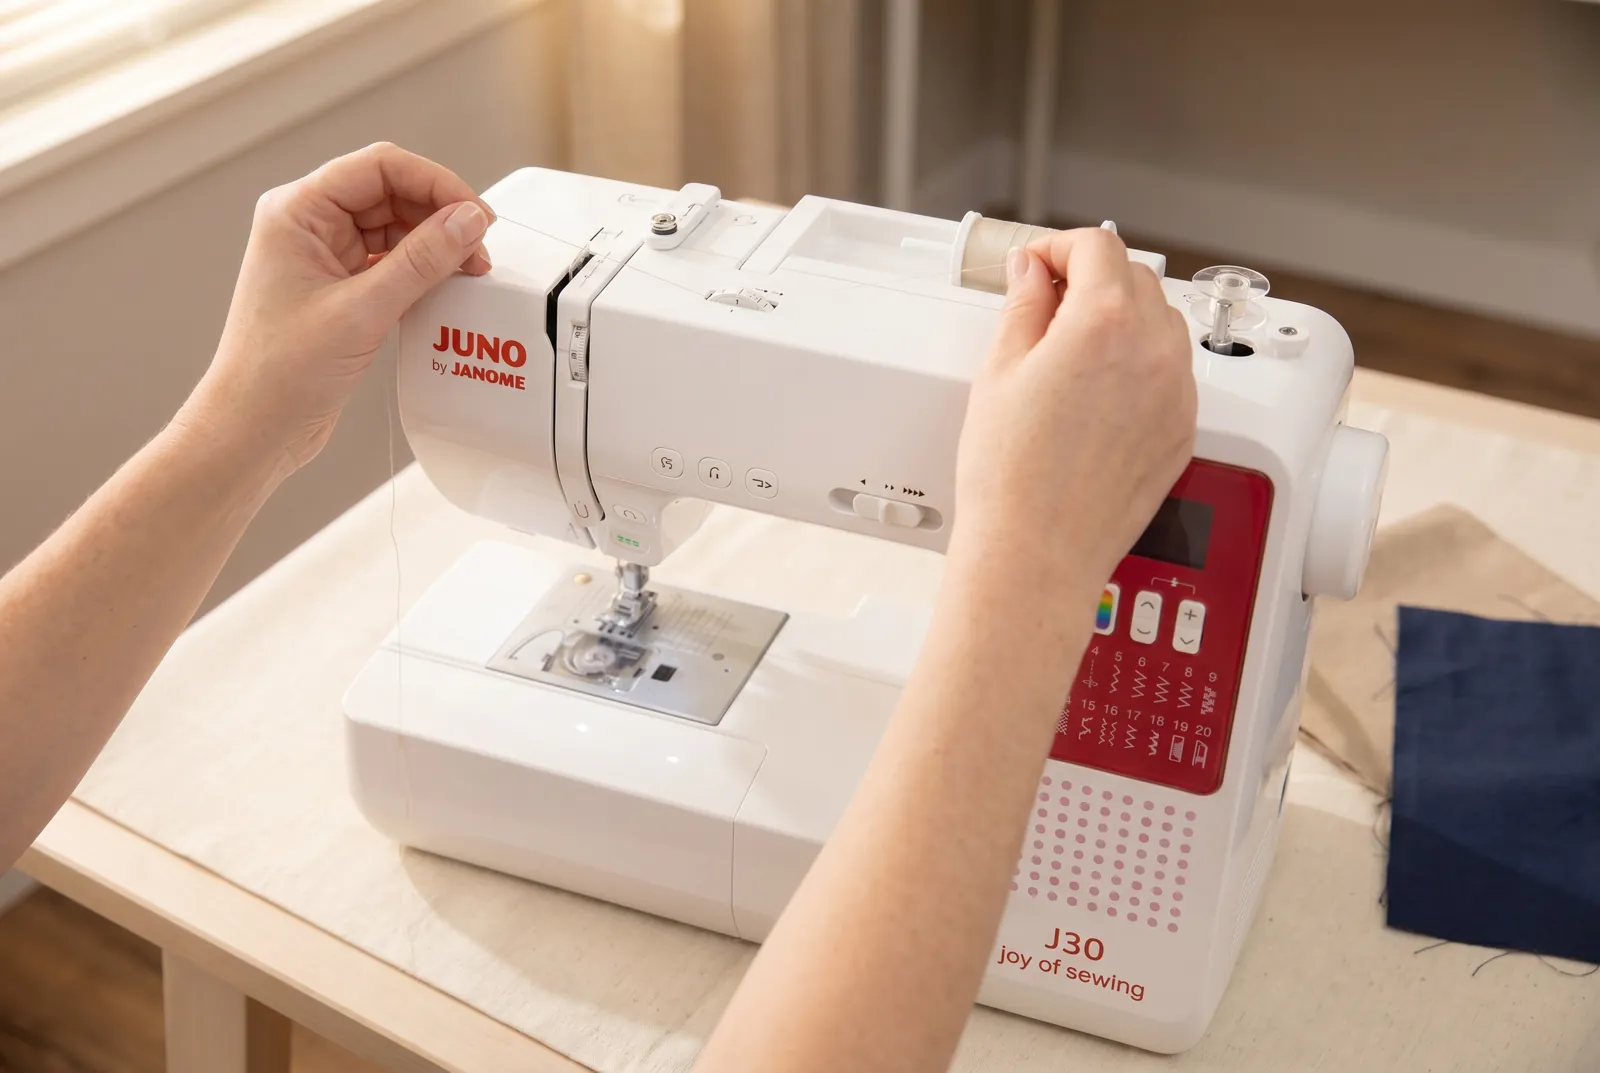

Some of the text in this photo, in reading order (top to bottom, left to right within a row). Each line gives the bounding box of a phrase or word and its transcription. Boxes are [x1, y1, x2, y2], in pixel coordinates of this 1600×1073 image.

[432, 325, 527, 368] JUNO
[432, 359, 526, 391] by JANOME
[1091, 646, 1218, 682] 4 5 6 7 8 9
[1081, 698, 1096, 711] 15
[1104, 704, 1118, 716] 16
[1126, 709, 1142, 721] 17
[1150, 715, 1165, 727] 18
[1173, 720, 1189, 732] 19
[1195, 725, 1212, 737] 20
[1044, 927, 1105, 961] J30
[997, 945, 1145, 1001] joy of sewing
